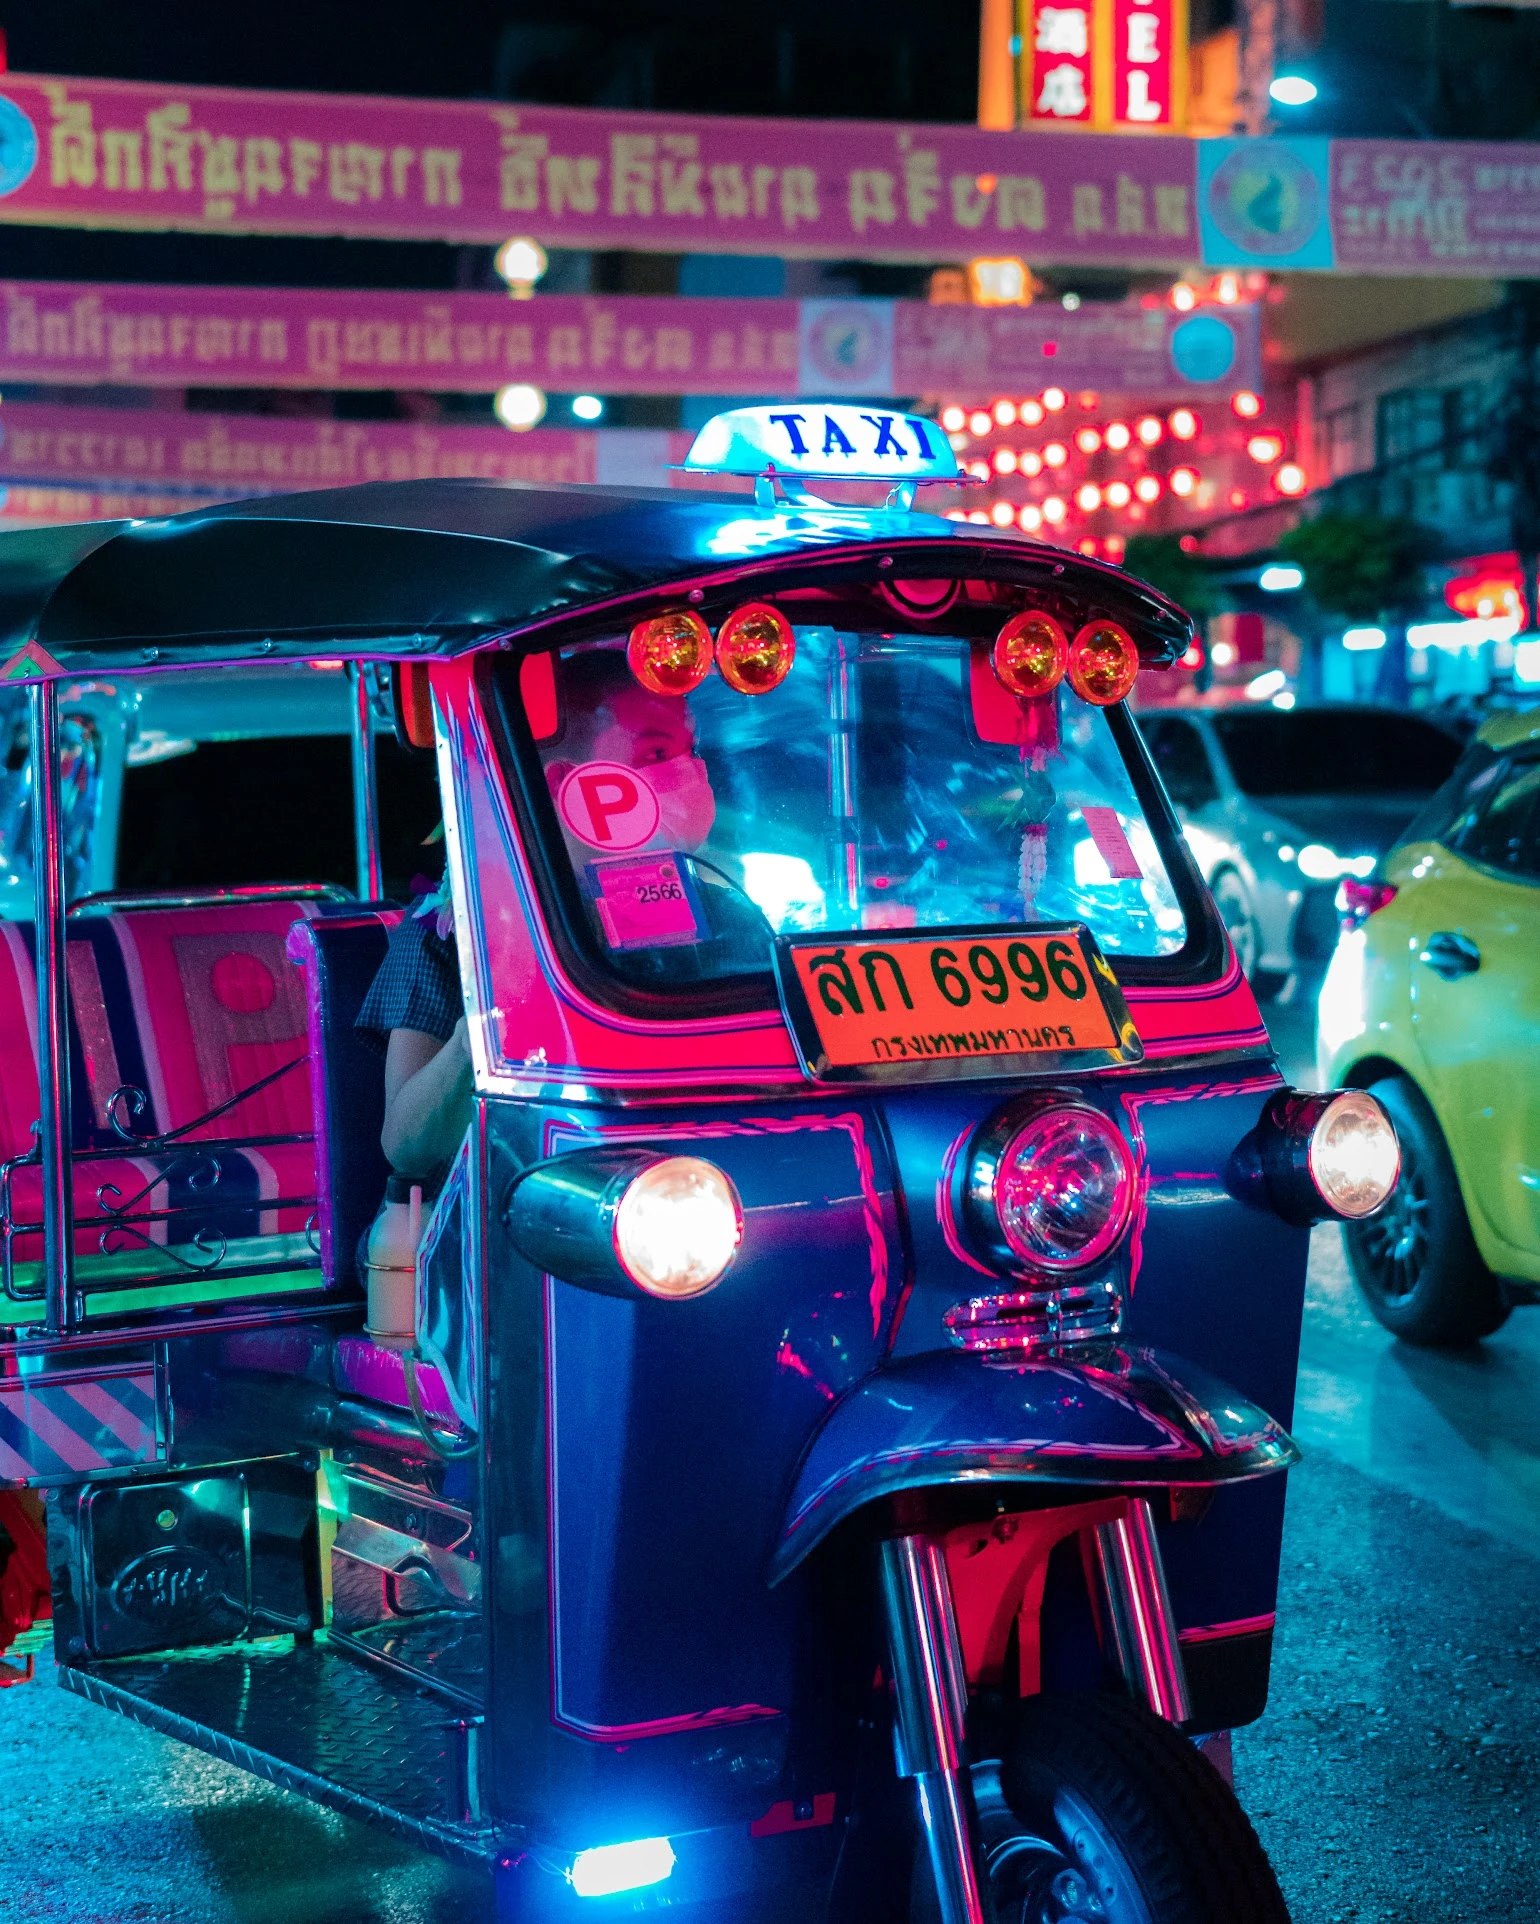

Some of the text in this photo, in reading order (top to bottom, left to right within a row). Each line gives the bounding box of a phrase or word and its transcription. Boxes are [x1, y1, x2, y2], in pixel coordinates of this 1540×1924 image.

[1126, 0, 1162, 122] EL
[769, 413, 937, 460] TAXI
[577, 772, 639, 842] P
[637, 883, 683, 904] 2566
[809, 940, 1089, 1017] สก 6996
